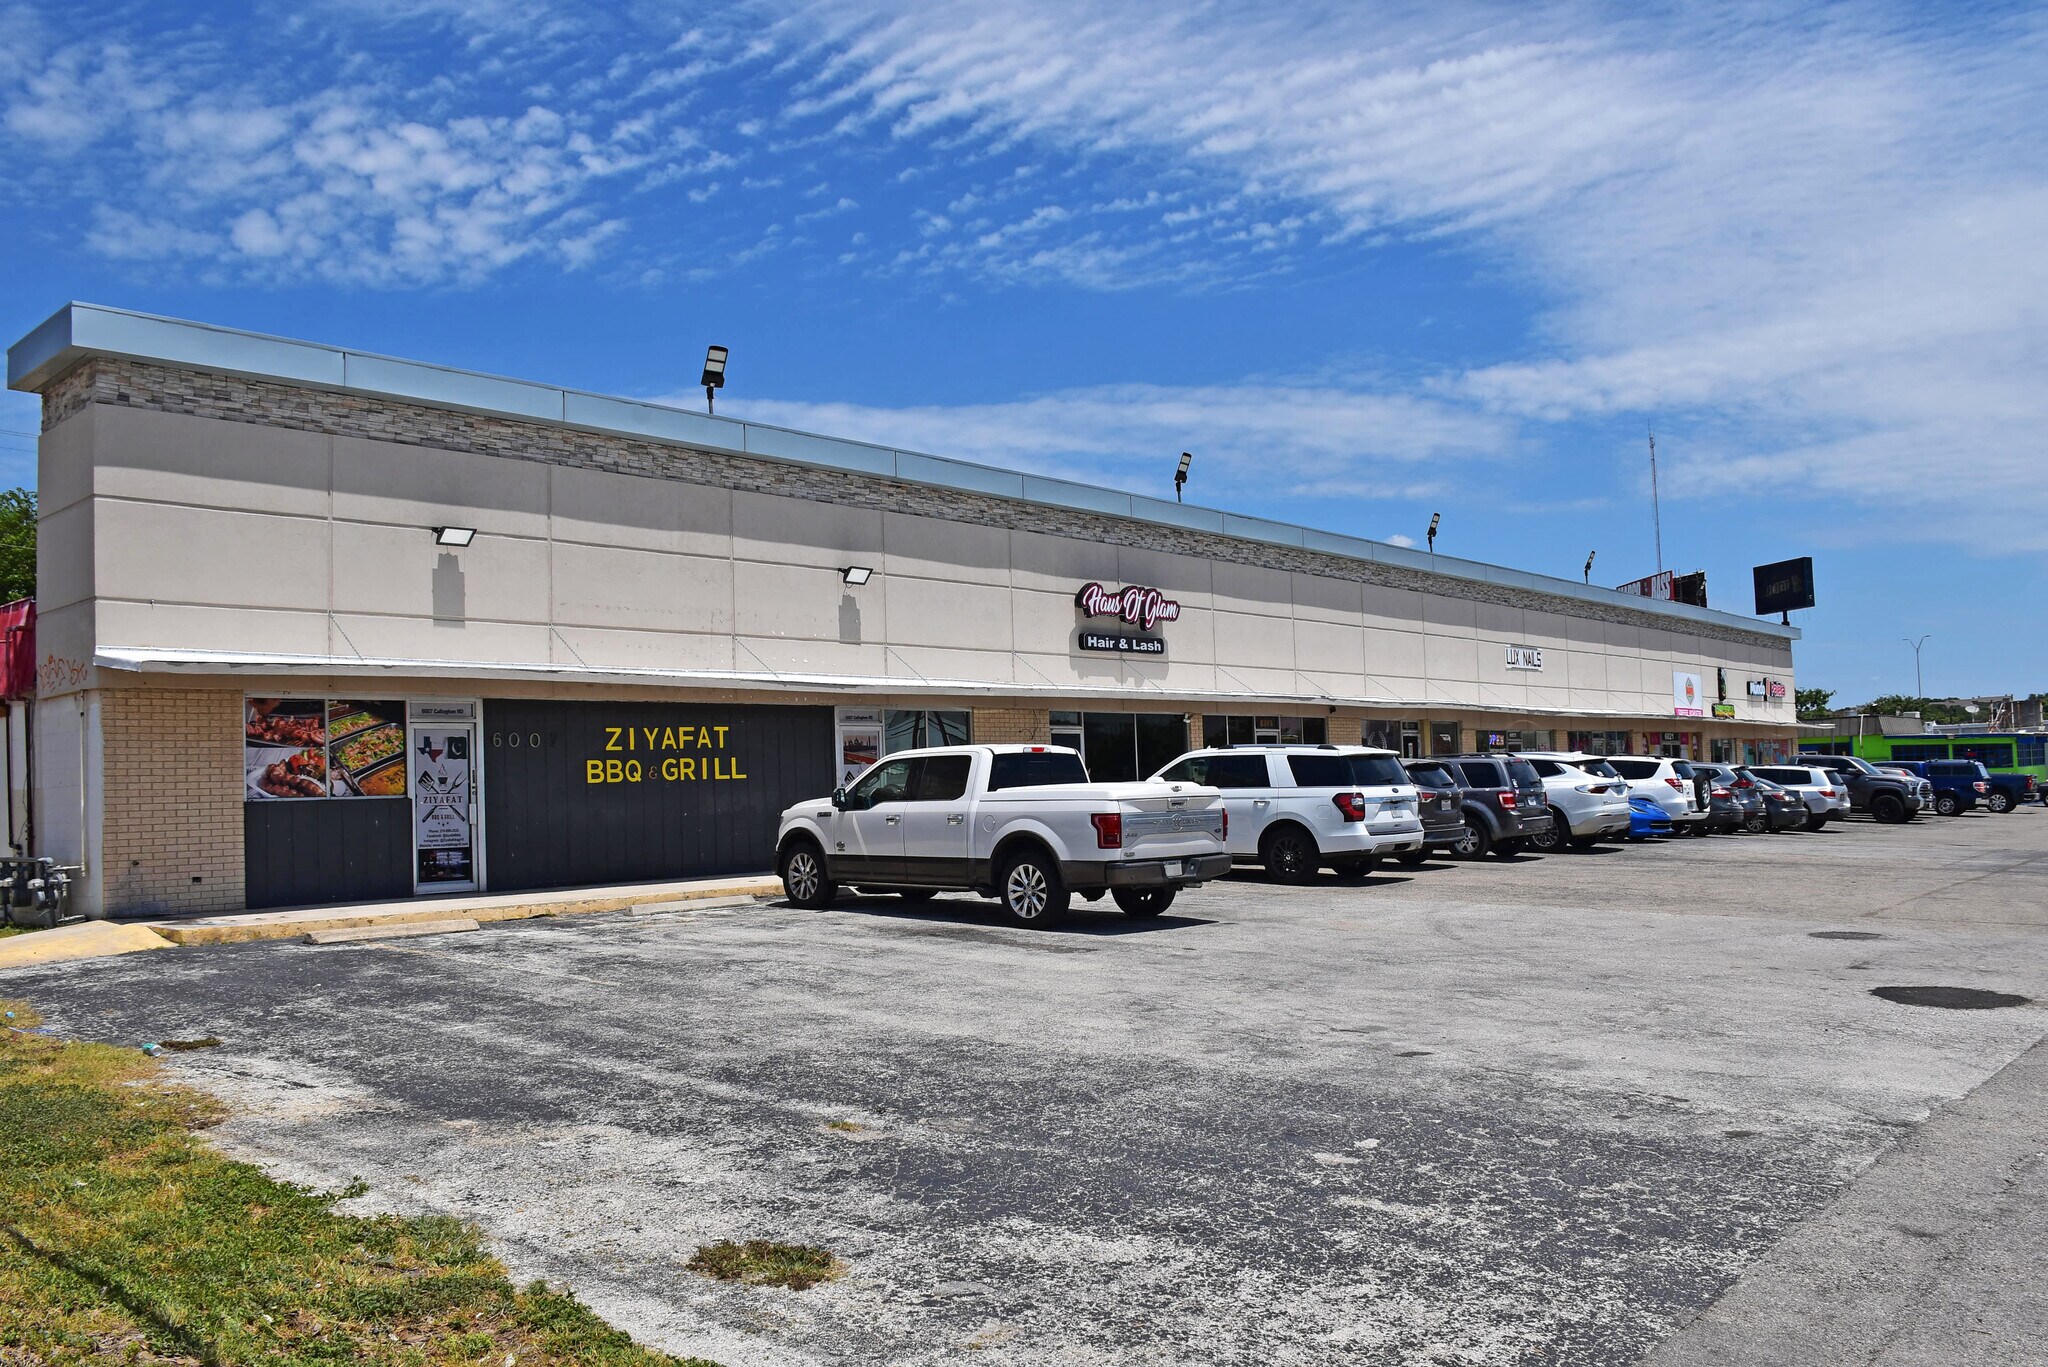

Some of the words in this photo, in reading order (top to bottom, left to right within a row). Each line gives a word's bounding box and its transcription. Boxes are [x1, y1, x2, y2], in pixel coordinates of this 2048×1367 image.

[1083, 585, 1122, 615] Haus
[1123, 588, 1146, 622] Of
[1145, 591, 1179, 628] Glam
[1087, 636, 1115, 649] Hair
[1119, 638, 1128, 649] &
[1132, 639, 1161, 651] Lash
[1505, 648, 1520, 665] LUX
[1522, 650, 1542, 667] NAILS
[605, 726, 729, 751] ZIYAFAT
[586, 759, 642, 784] BBQ
[648, 765, 658, 780] &
[661, 757, 747, 781] GRILL
[423, 795, 463, 804] ZIYAFAT
